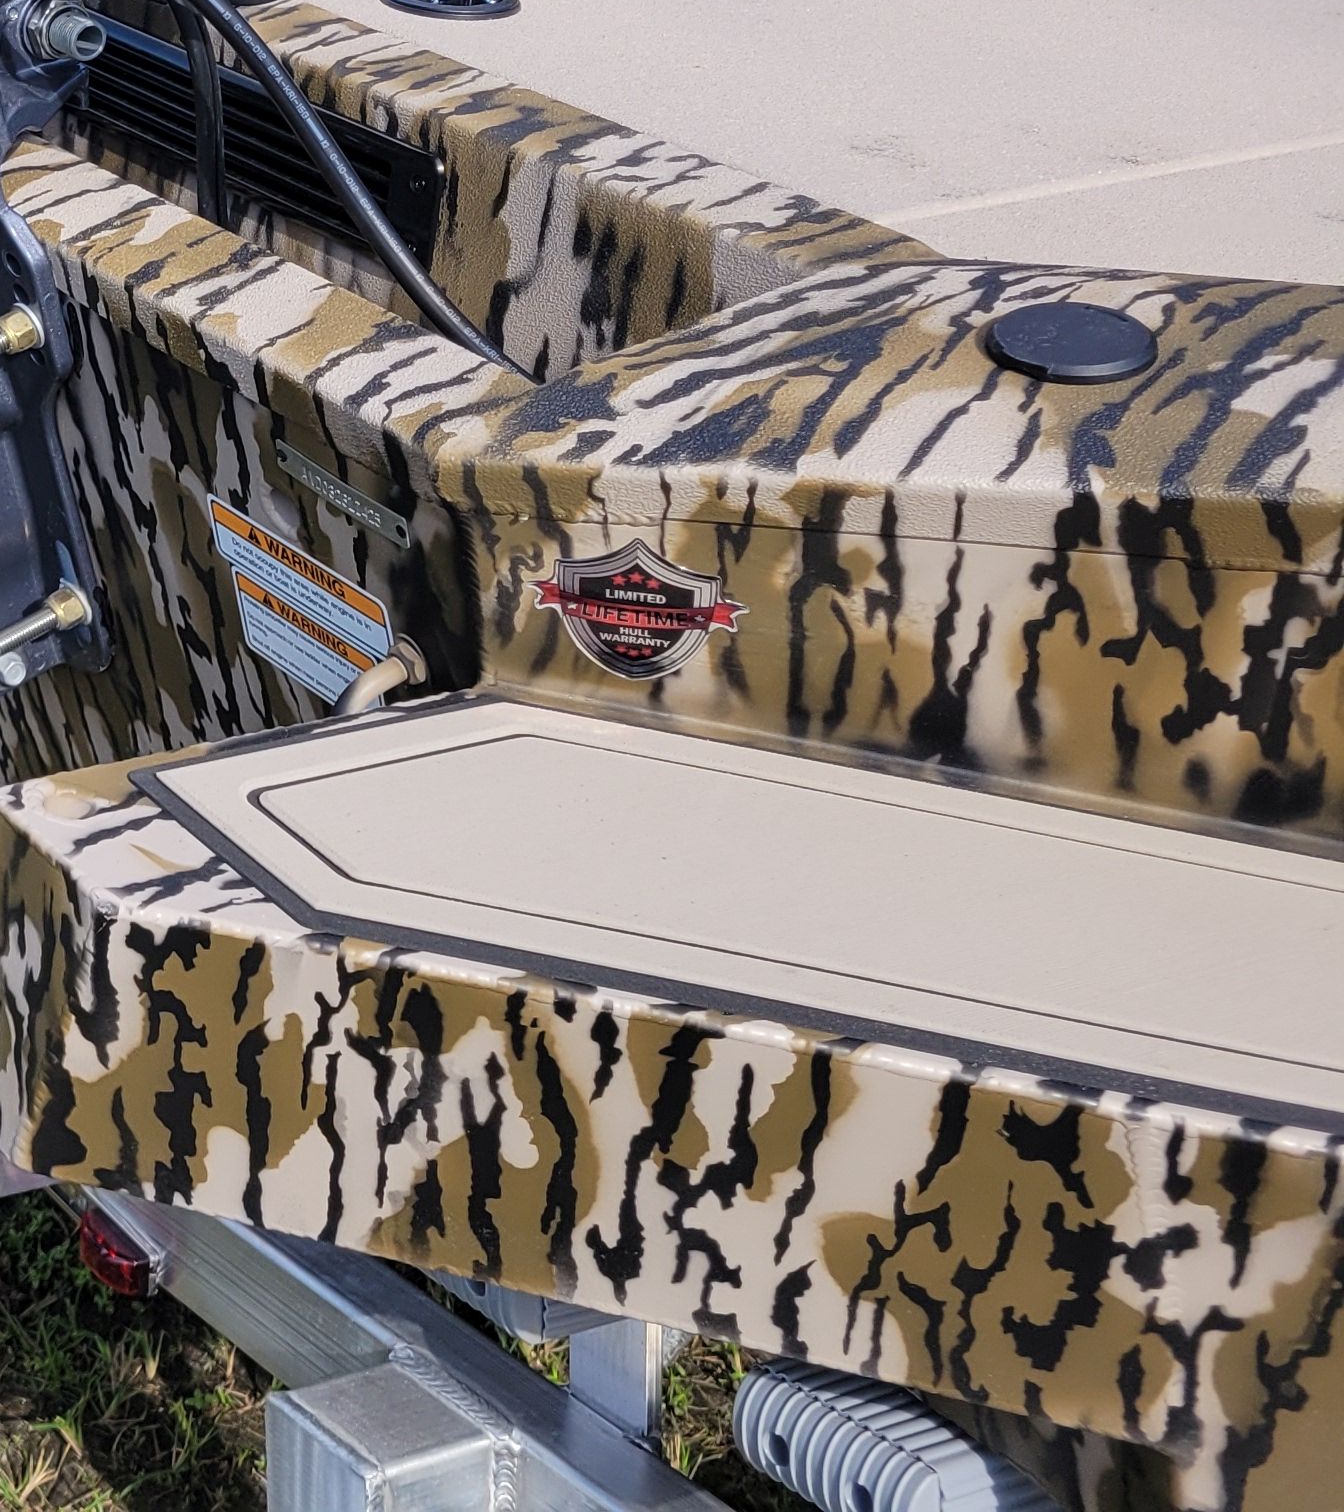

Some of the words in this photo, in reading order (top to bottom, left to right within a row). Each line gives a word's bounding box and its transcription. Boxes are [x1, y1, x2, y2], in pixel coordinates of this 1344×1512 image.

[263, 536, 346, 599] WARNING
[605, 588, 667, 605] LIMITED
[582, 600, 689, 628] LIFETIME
[277, 600, 349, 657] WARNING
[599, 631, 671, 648] WARRANTY
[619, 626, 651, 638] HULL
